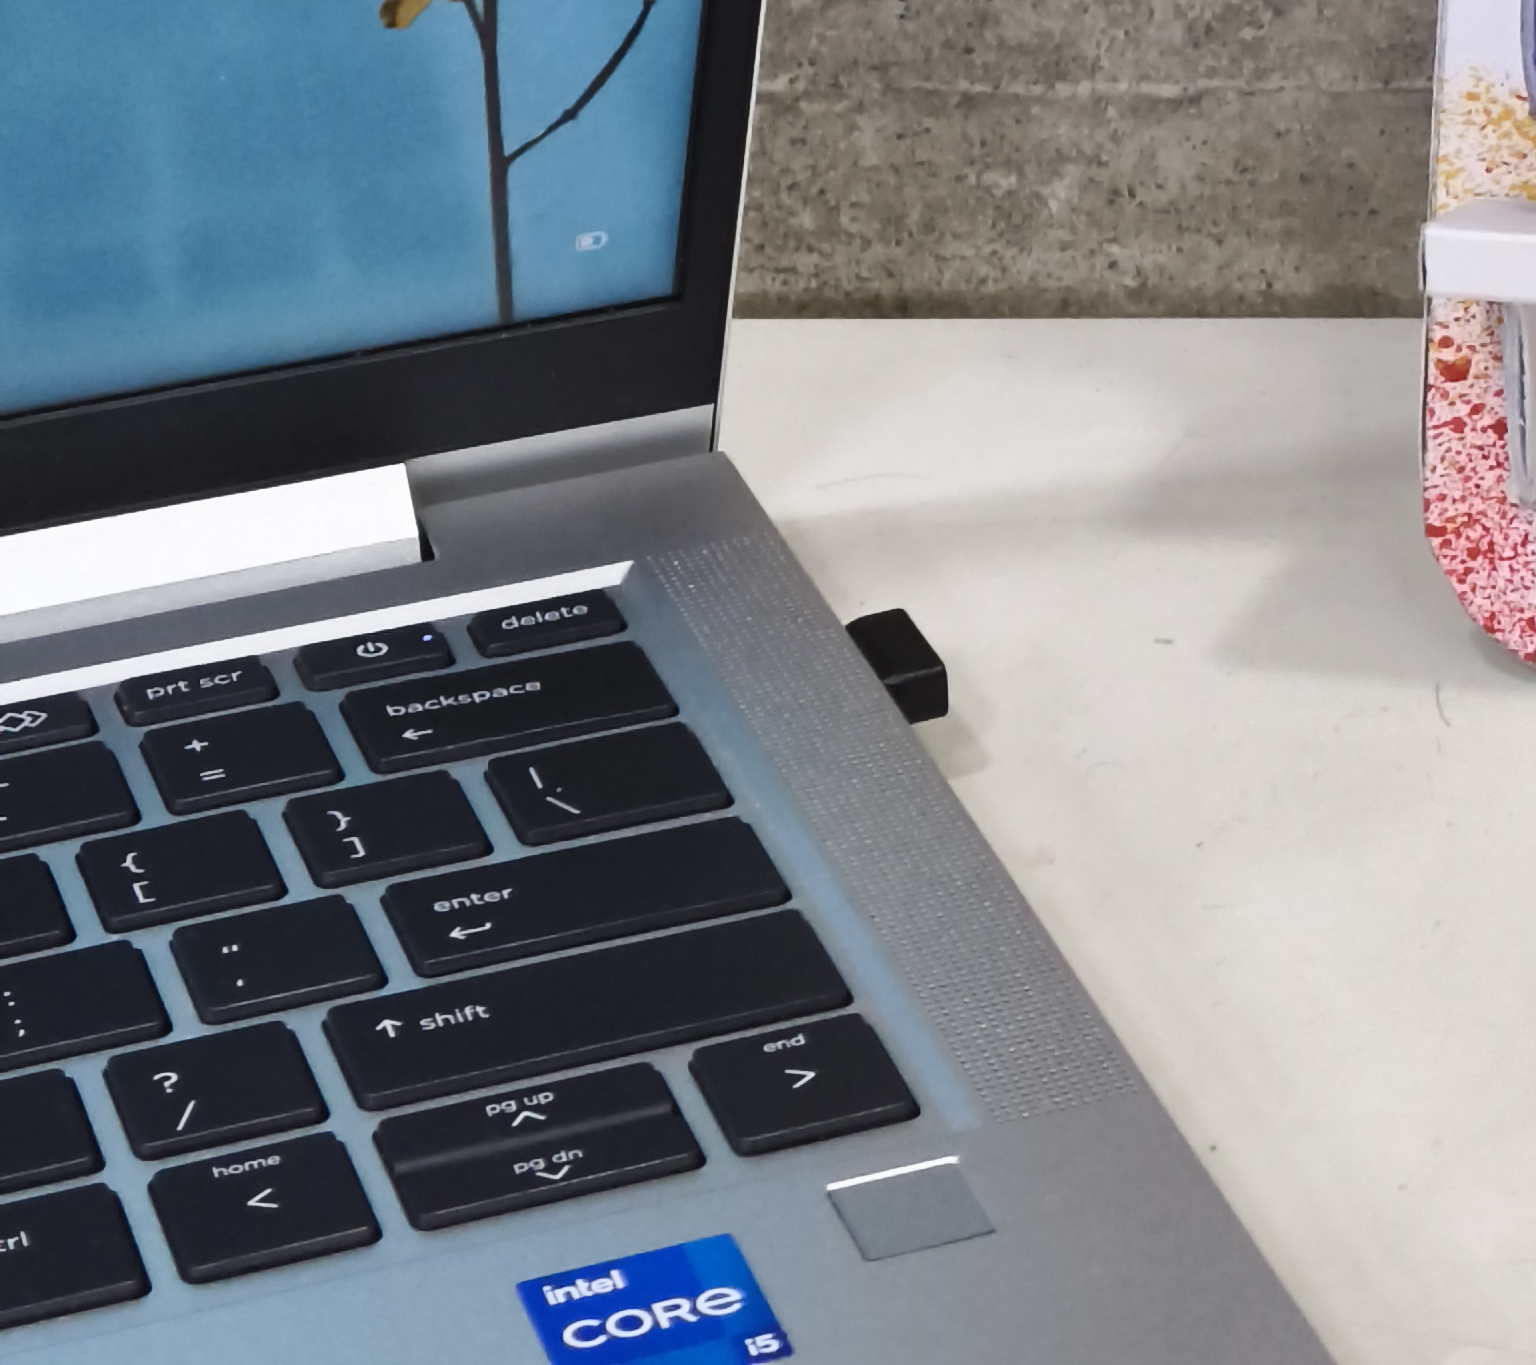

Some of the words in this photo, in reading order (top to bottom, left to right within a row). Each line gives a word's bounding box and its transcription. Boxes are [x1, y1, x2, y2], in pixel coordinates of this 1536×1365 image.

[500, 602, 589, 630] delete
[146, 678, 191, 700] prt
[199, 670, 243, 689] scr
[385, 679, 541, 717] backspace
[342, 836, 366, 859] ]
[132, 880, 156, 904] [
[433, 885, 513, 912] enter
[419, 1004, 490, 1031] shift
[763, 1033, 806, 1054] end
[152, 1071, 179, 1094] ?
[485, 1097, 518, 1118] pg
[522, 1090, 555, 1107] up
[211, 1152, 282, 1179] home
[513, 1155, 548, 1175] pg
[551, 1147, 584, 1164] dn
[542, 1268, 626, 1306] intel
[744, 1332, 781, 1357] i5
